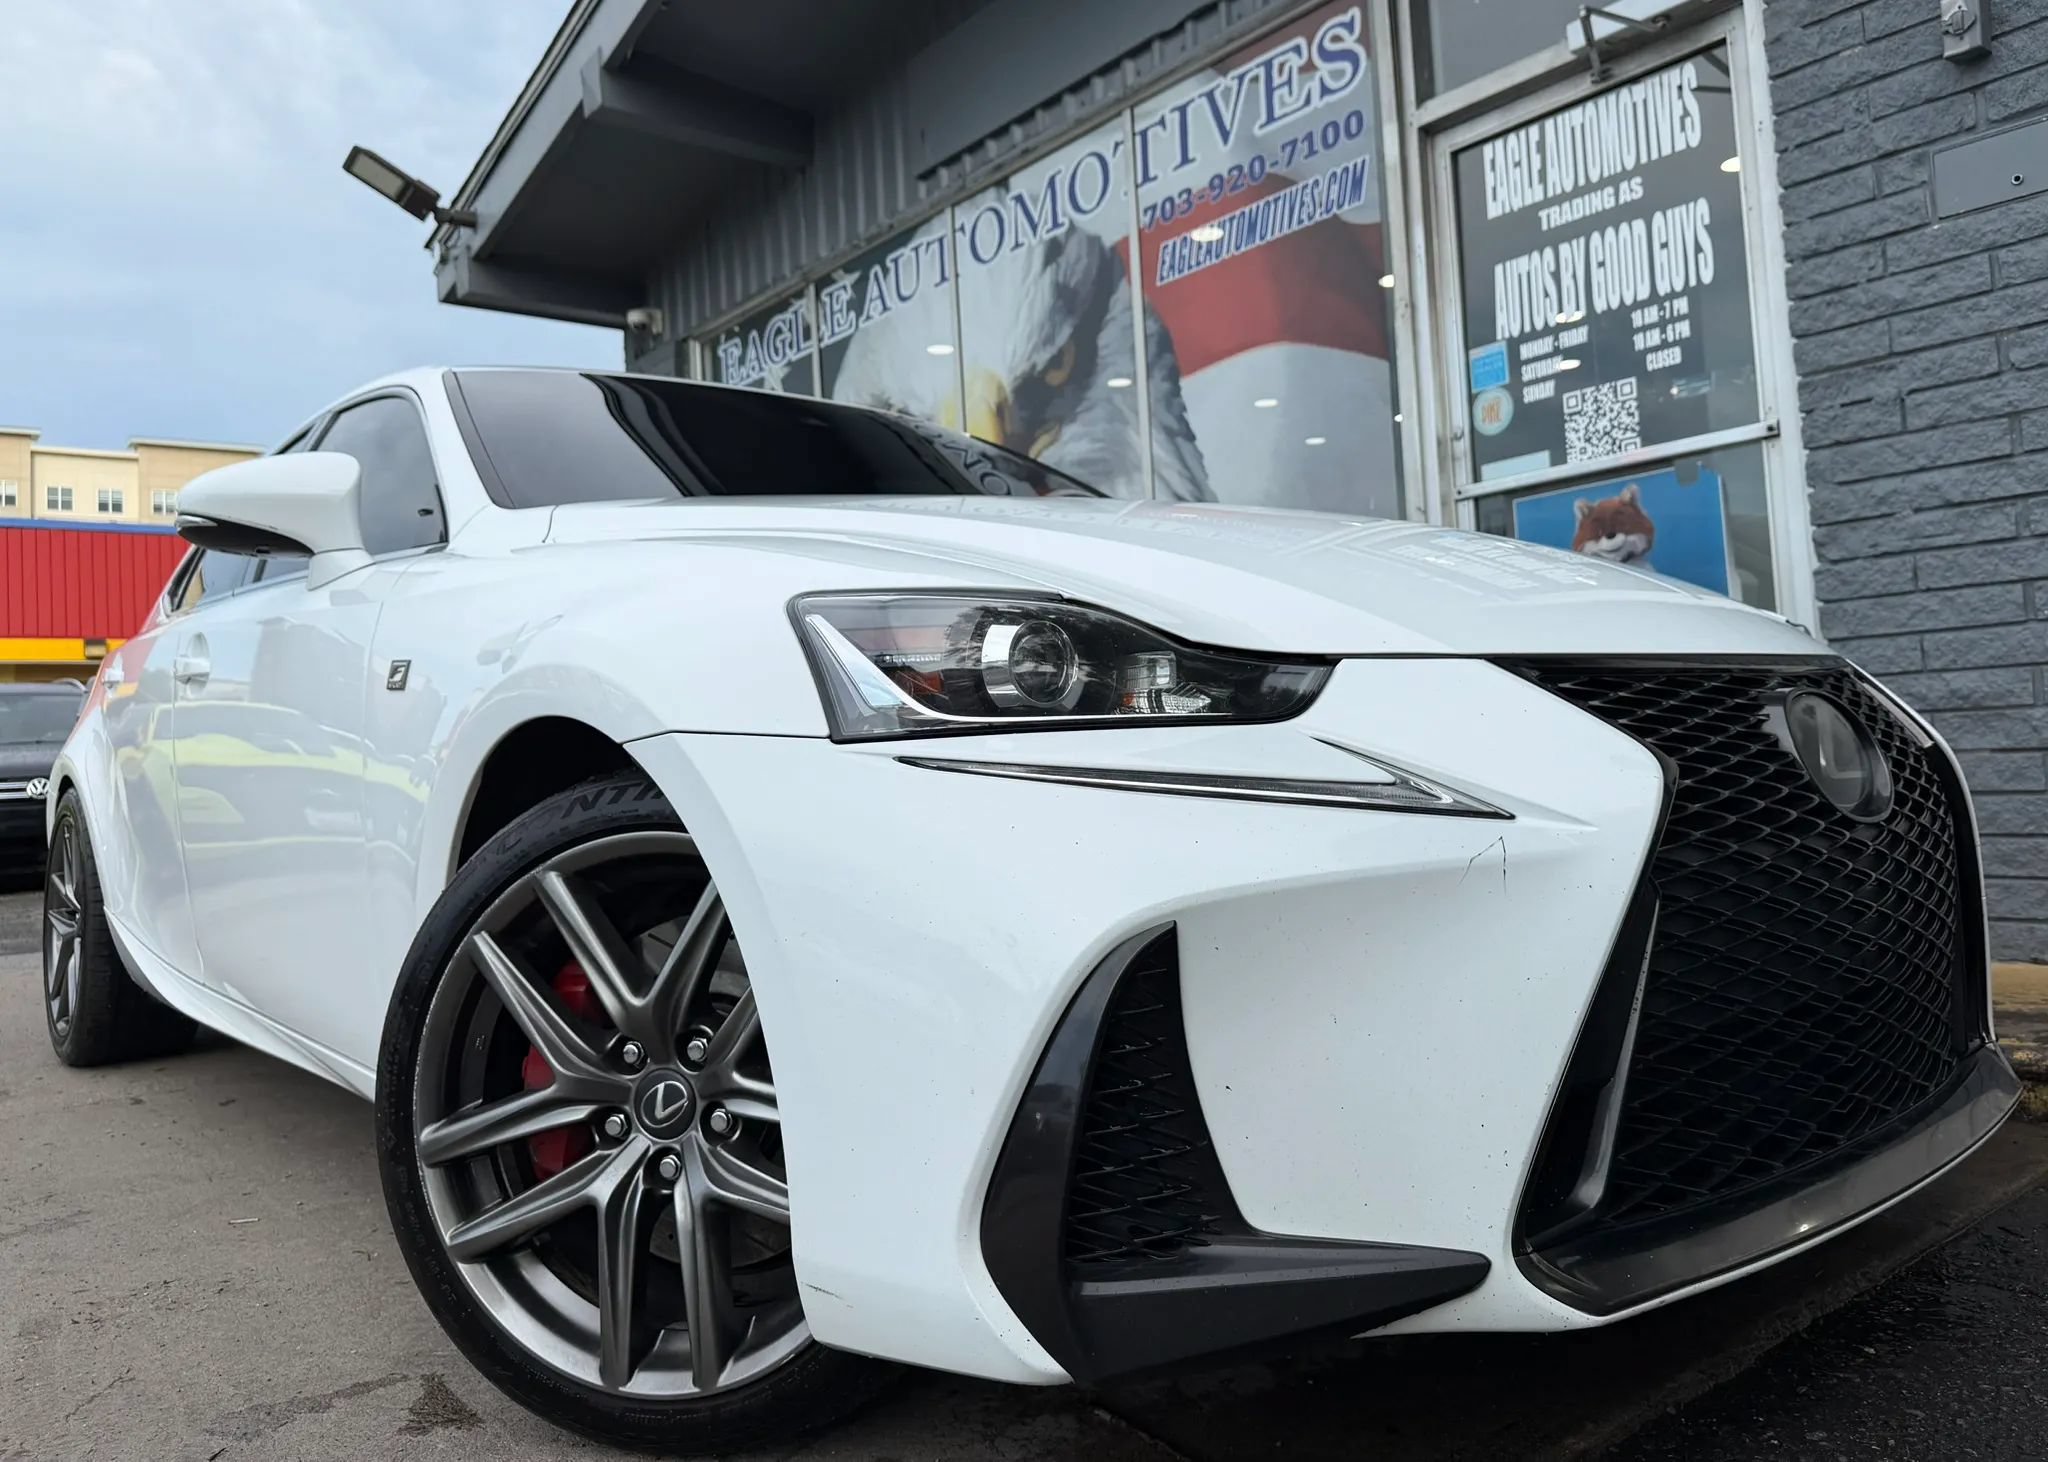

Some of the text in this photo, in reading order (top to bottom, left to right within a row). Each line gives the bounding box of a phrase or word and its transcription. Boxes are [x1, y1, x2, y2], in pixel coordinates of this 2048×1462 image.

[719, 7, 1367, 386] EAGLE AUTOMOTIVES
[1143, 109, 1365, 232] 703-920-7100
[1483, 62, 1702, 220] EAGLE AUTOMOTIVES
[1157, 155, 1369, 286] EAGLEAUTOMOTIVES.COM
[1538, 176, 1644, 231] TRADING AS
[1494, 197, 1714, 341] AUTOS BY GOOD GUYS
[1519, 335, 1554, 361] MONDAY
[1559, 324, 1588, 350] FRIDAY
[1522, 379, 1555, 404] SUNDAY
[1646, 345, 1682, 372] CLOSED
